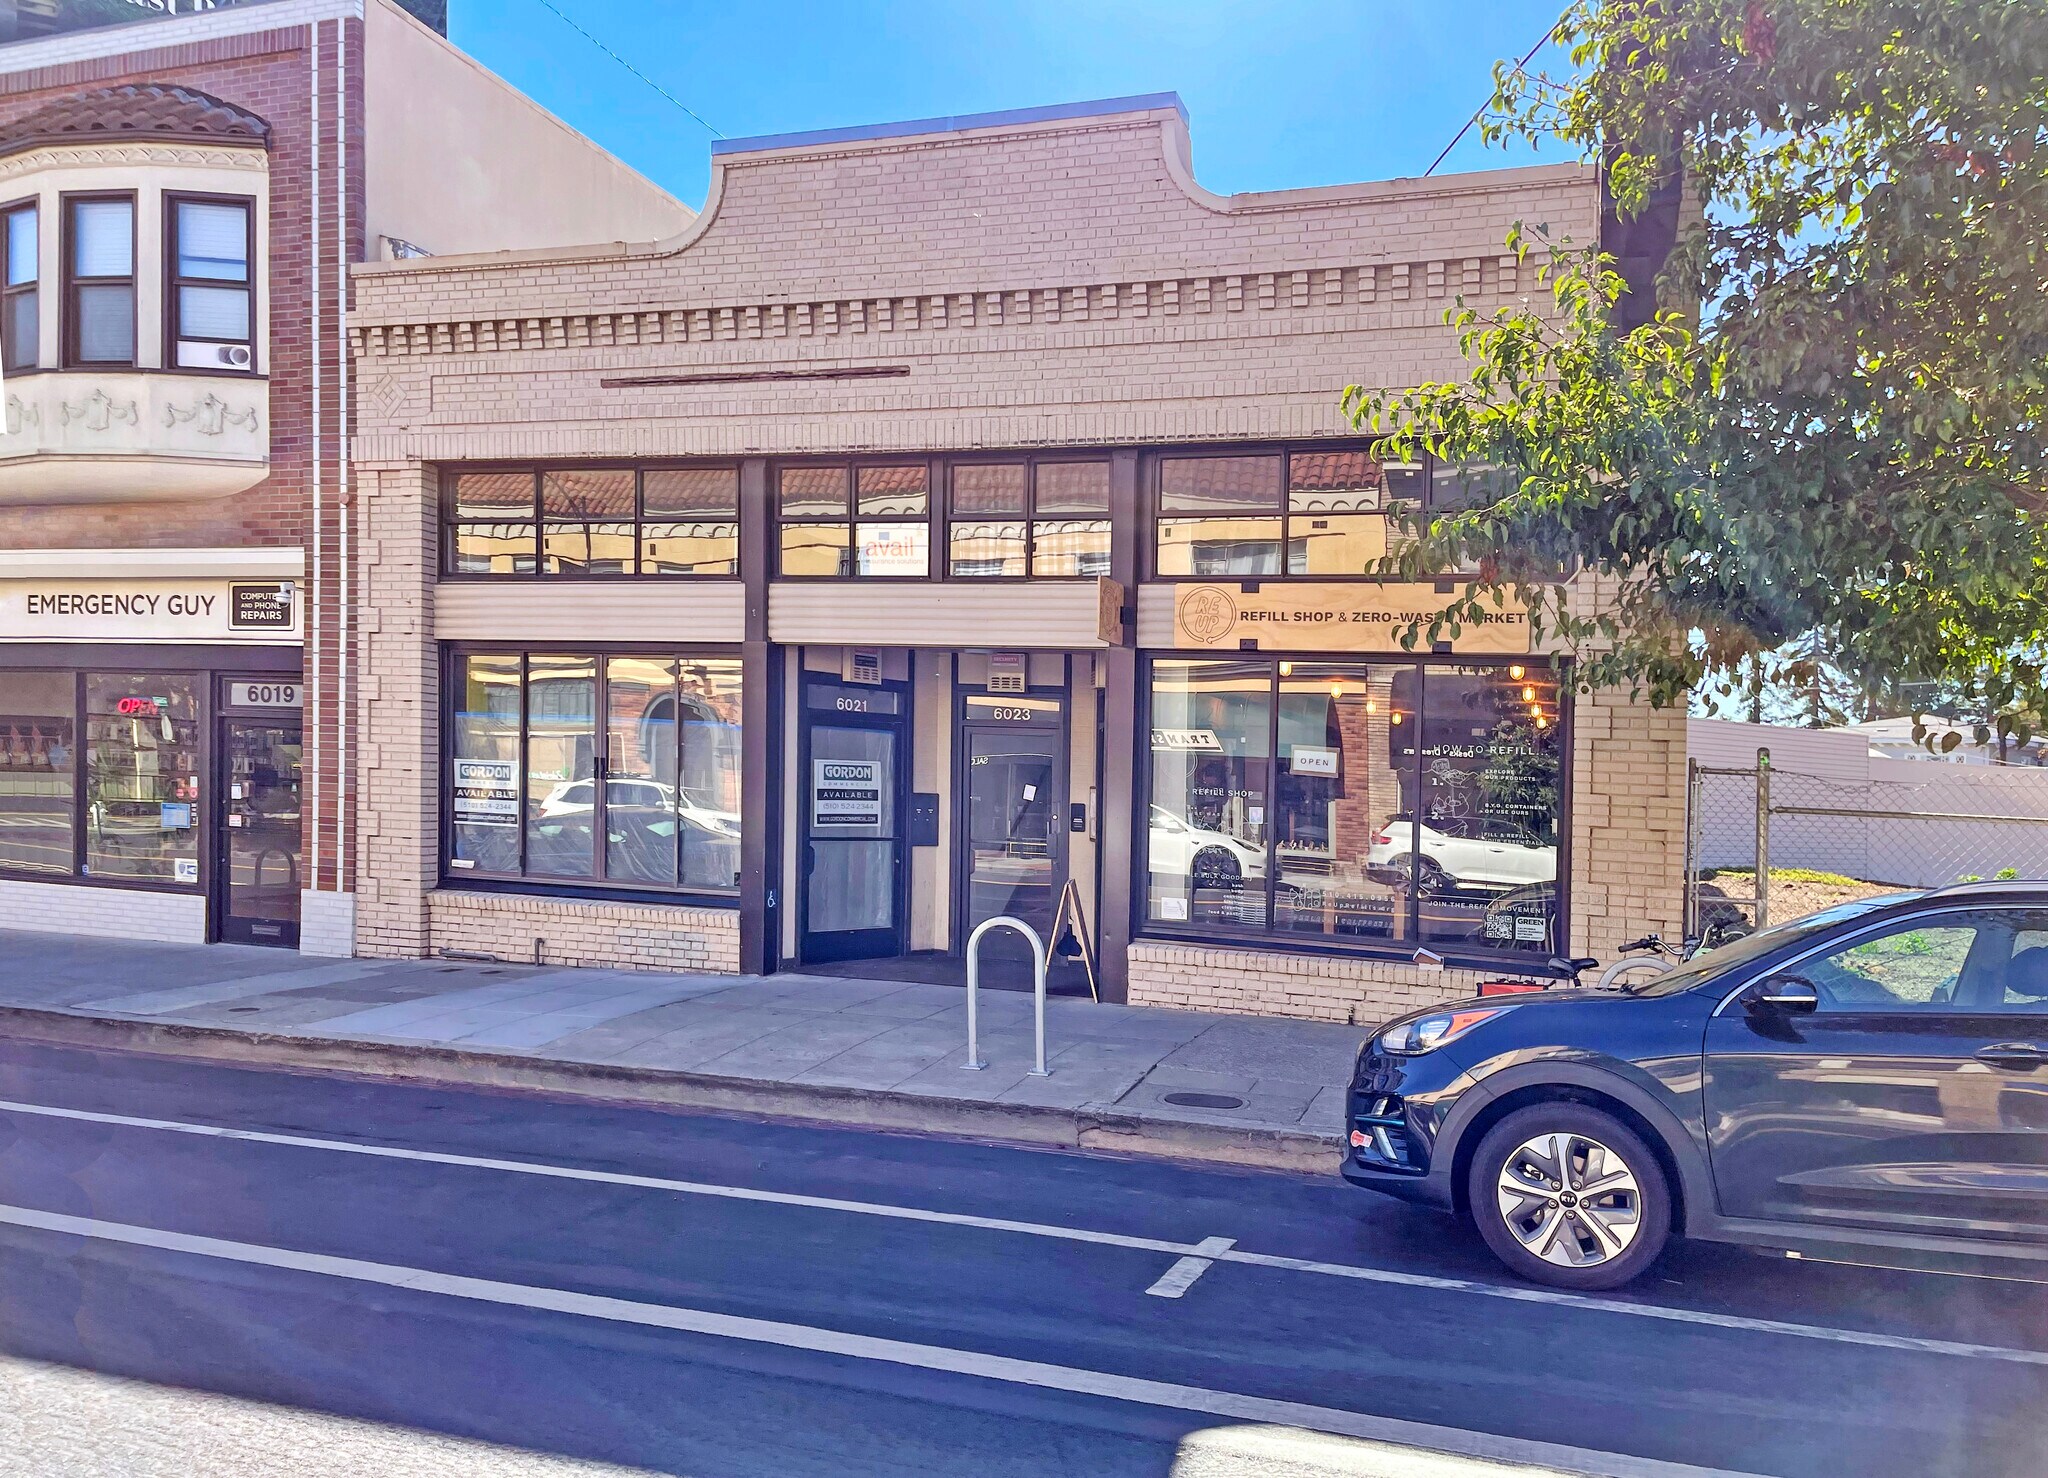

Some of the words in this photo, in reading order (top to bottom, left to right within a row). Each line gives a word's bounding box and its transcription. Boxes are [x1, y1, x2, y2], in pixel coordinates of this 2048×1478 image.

[866, 536, 913, 557] avail
[240, 592, 278, 600] COMPUTE
[27, 594, 160, 615] EMERGENCY
[167, 595, 216, 616] GUY
[1195, 596, 1222, 615] RE
[240, 611, 282, 620] REPAIRS
[1240, 611, 1289, 621] REFILL
[1293, 611, 1334, 622] SHOP
[1338, 612, 1347, 622] &
[1352, 612, 1451, 623] ZERO-WAS
[1459, 613, 1526, 624] MRKET
[1194, 615, 1220, 634] UP
[247, 685, 295, 703] 6019
[836, 697, 867, 713] 6021
[993, 707, 1031, 721] 6023
[1468, 745, 1484, 754] TO
[1300, 757, 1329, 766] OPEN
[461, 765, 510, 778] GORDON
[825, 765, 872, 779] GORDON
[456, 789, 516, 799] AVAILABLE
[823, 791, 873, 799] AVAILABLE
[1227, 789, 1254, 797] SHOP
[1500, 905, 1547, 914] MOVEMENT
[1517, 918, 1544, 926] GREEN
[1561, 1195, 1576, 1204] KIA
